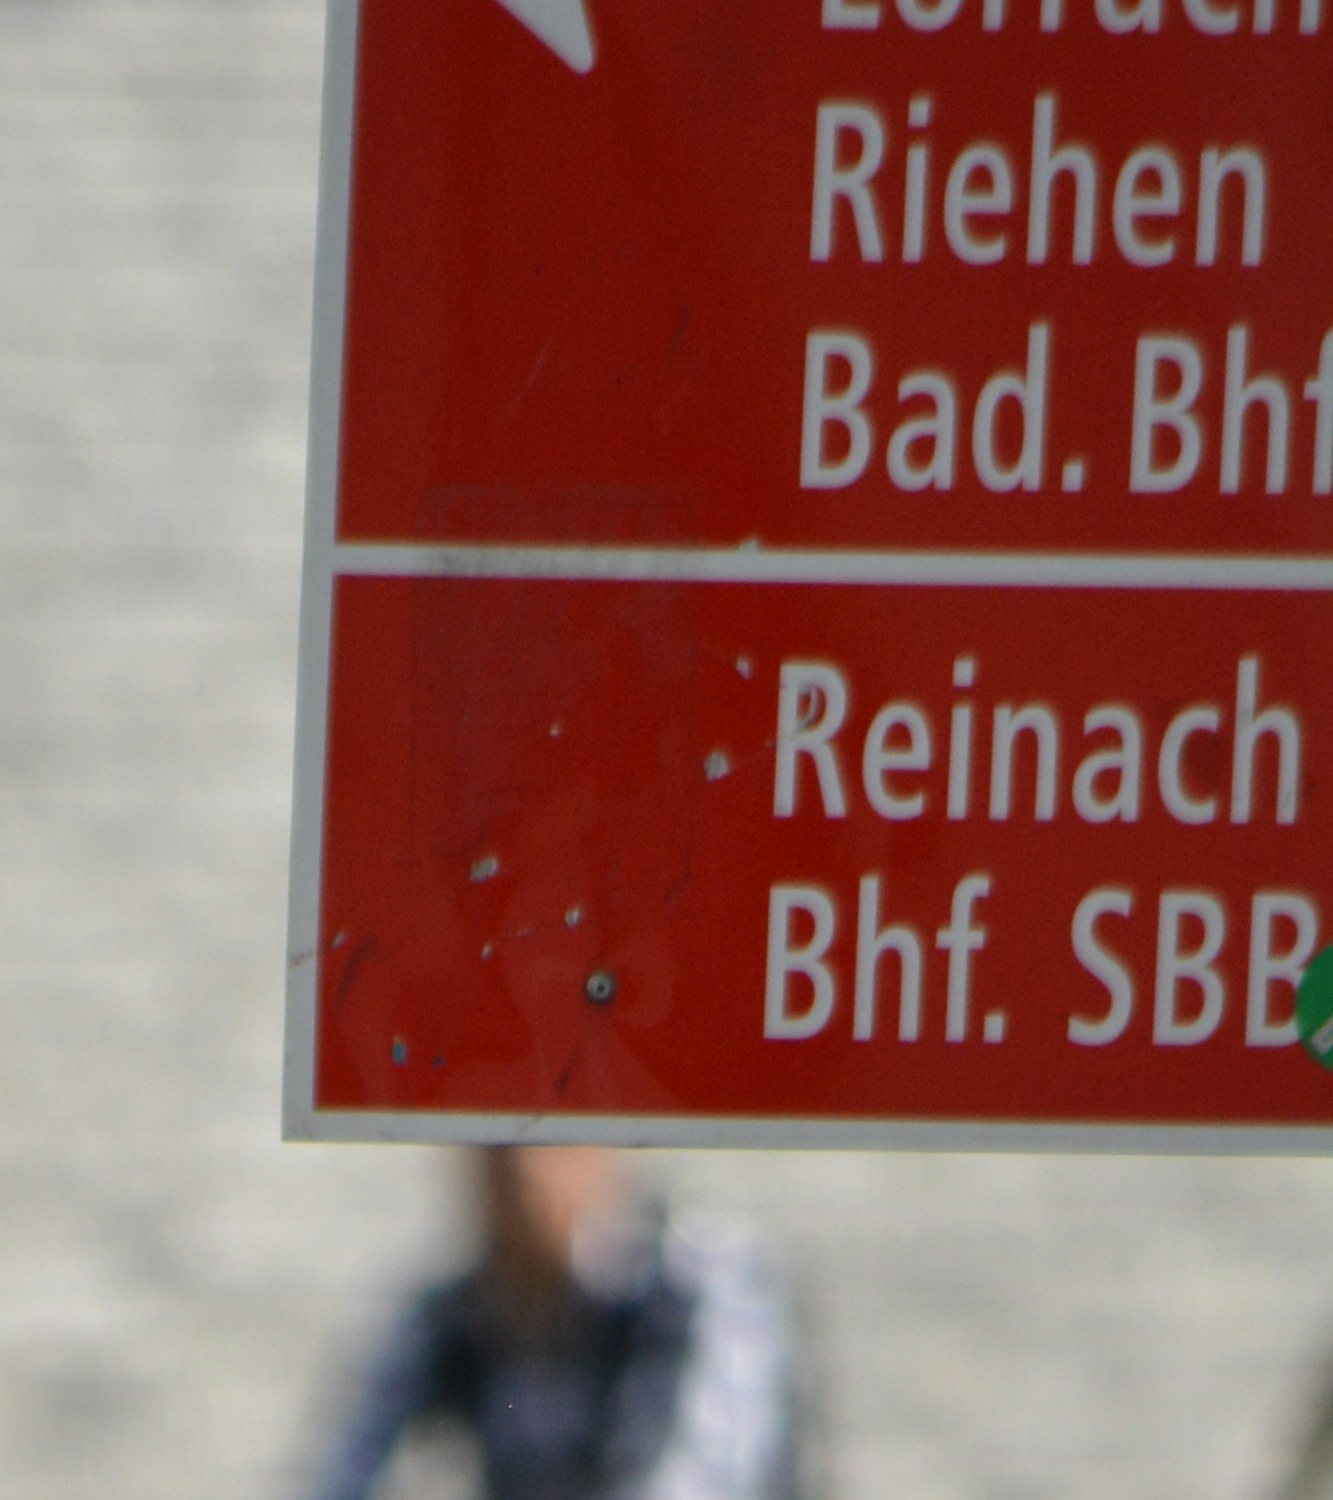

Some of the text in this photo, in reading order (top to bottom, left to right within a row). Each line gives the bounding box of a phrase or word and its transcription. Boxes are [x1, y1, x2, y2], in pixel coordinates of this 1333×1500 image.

[810, 95, 1268, 266] Riehen
[799, 323, 1086, 493] Bad.
[773, 657, 1302, 825] Reinach
[763, 874, 1319, 1048] Bhf. SBB
